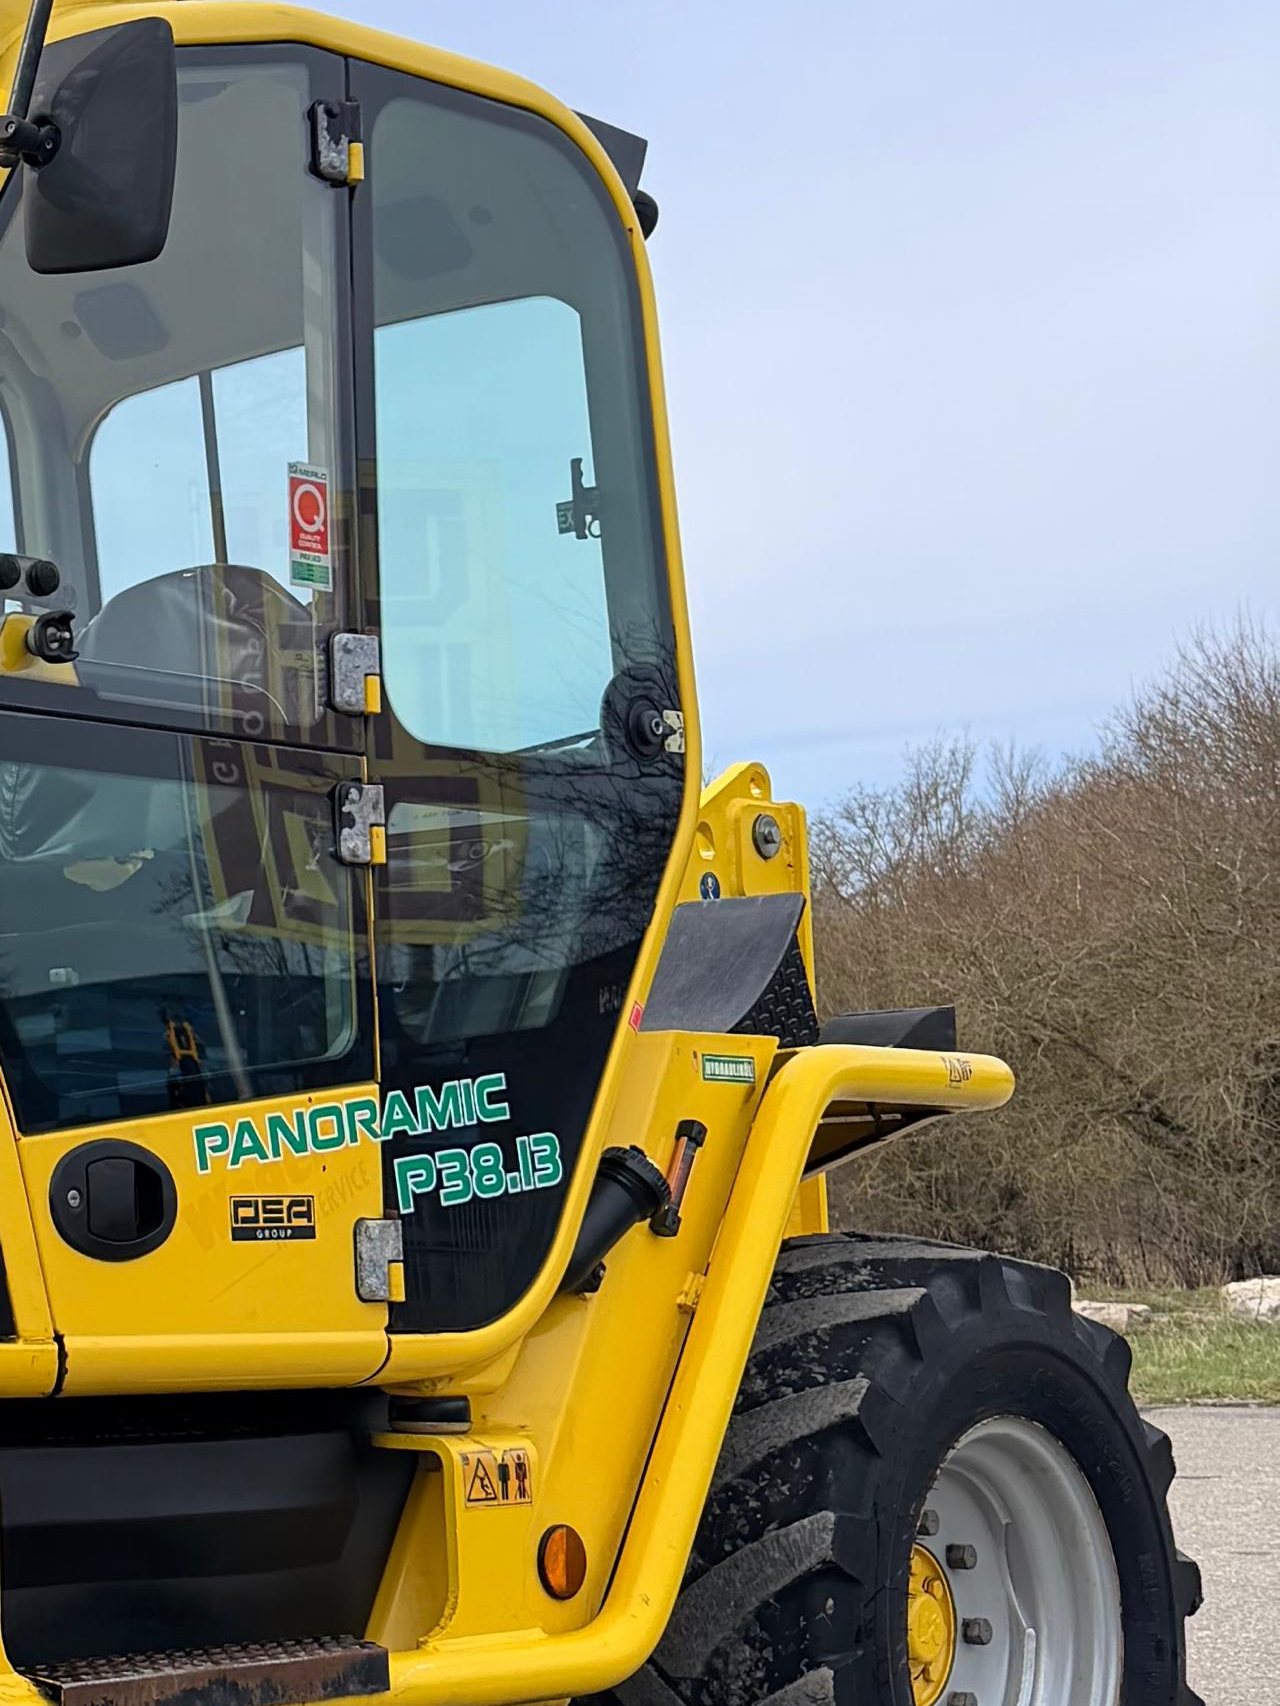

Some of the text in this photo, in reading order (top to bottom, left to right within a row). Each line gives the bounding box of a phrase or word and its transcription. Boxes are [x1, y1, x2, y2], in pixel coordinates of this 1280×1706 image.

[293, 483, 326, 533] Q
[192, 1072, 511, 1175] PANORAMIC
[393, 1131, 564, 1215] P38.13
[255, 1228, 293, 1239] GROUP
